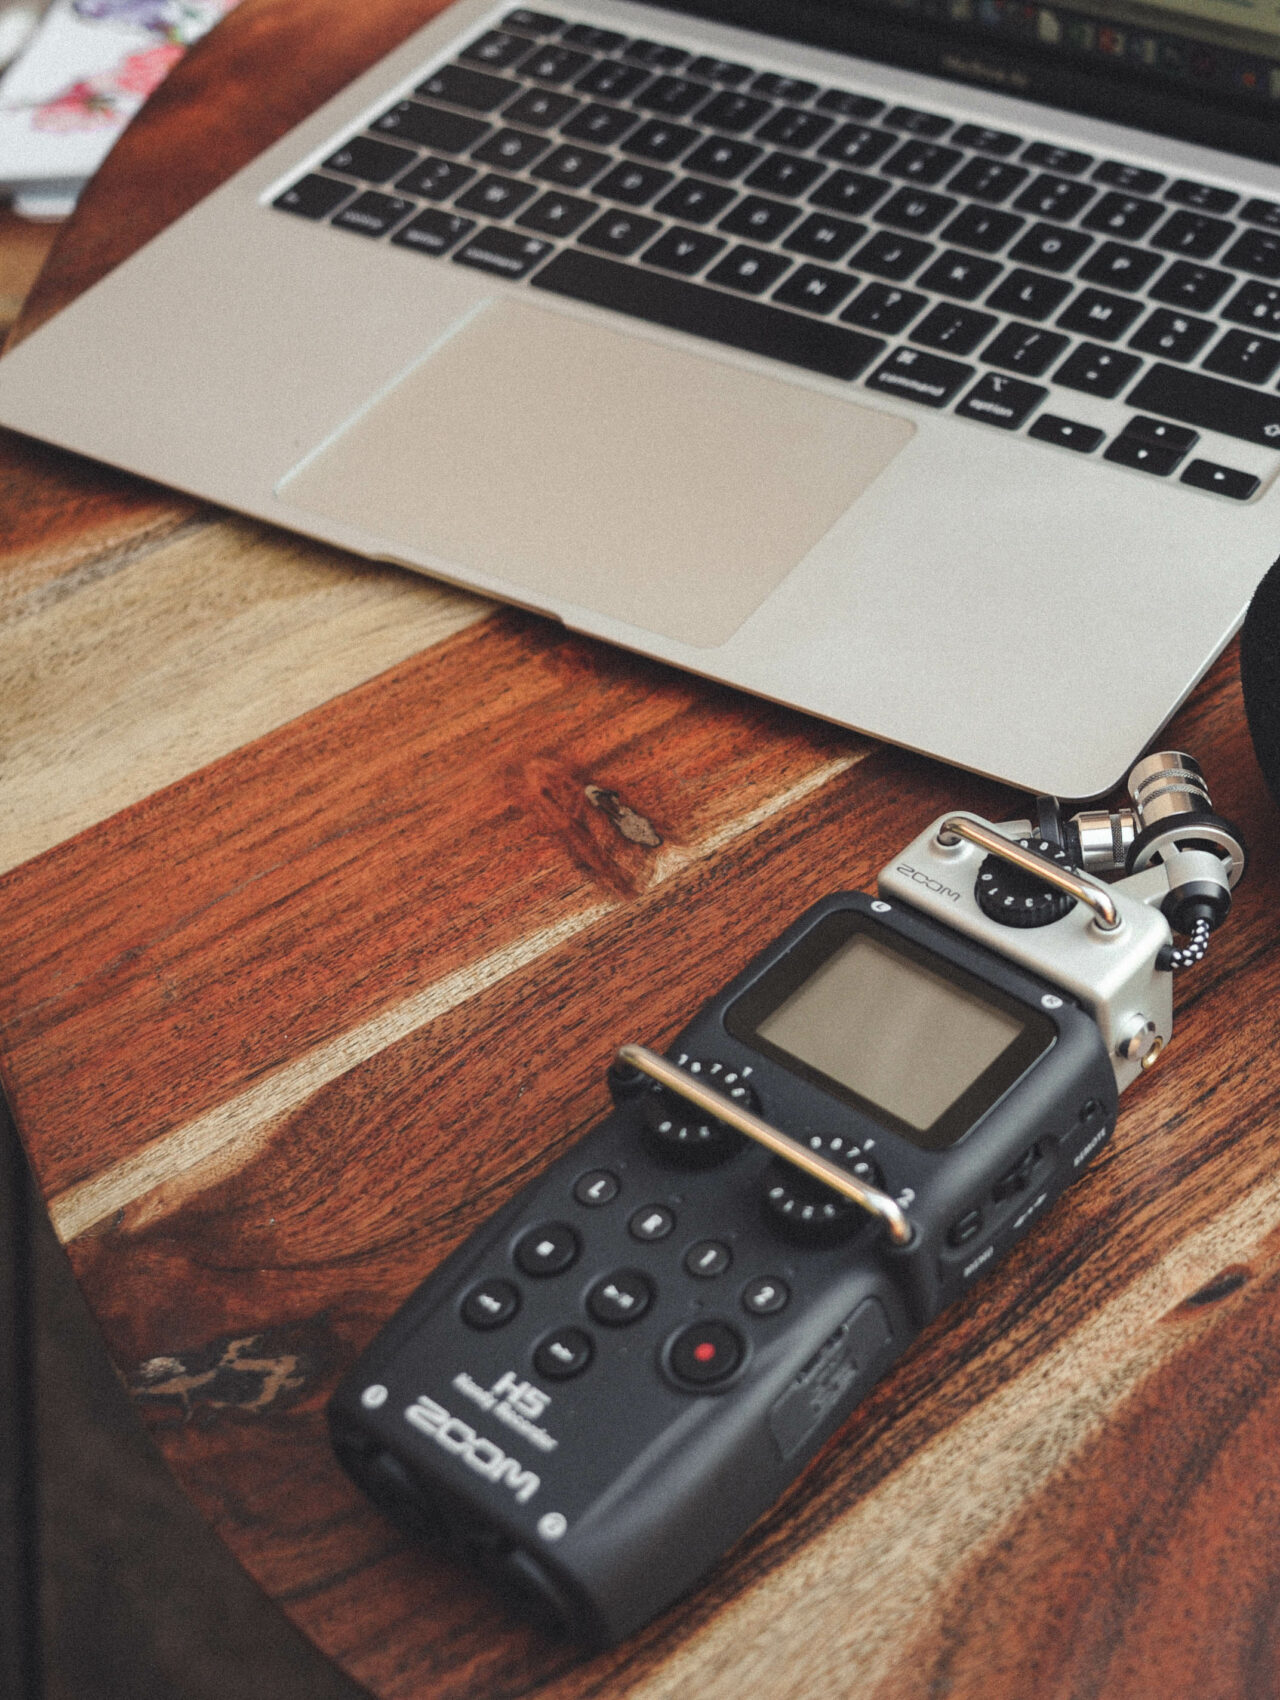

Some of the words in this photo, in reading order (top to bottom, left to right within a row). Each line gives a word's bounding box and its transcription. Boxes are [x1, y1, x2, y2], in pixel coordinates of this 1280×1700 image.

[1039, 841, 1049, 851] 8
[1054, 850, 1066, 859] 7
[896, 863, 961, 902] ZOOM
[981, 873, 993, 881] 0
[987, 887, 998, 896] 1
[1004, 896, 1015, 906] 2
[1025, 898, 1034, 908] 3
[588, 1180, 606, 1198] L
[897, 1187, 916, 1210] 2
[698, 1249, 718, 1268] 1
[753, 1286, 775, 1306] 2
[492, 1370, 552, 1420] H5
[404, 1395, 541, 1503] ZOOM
